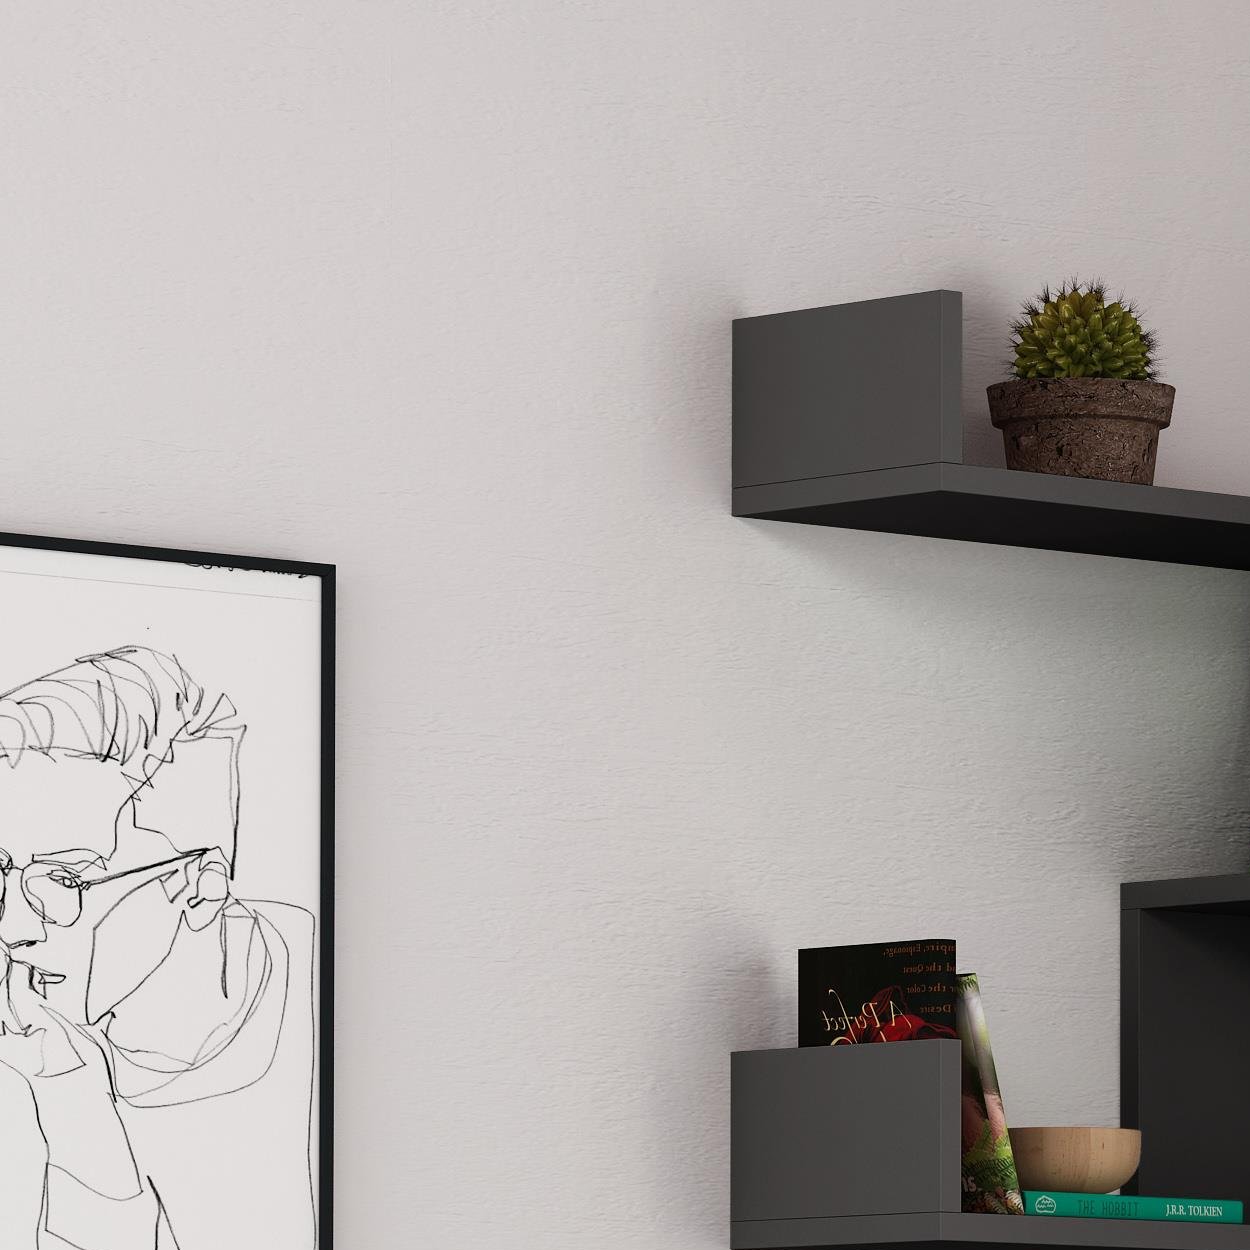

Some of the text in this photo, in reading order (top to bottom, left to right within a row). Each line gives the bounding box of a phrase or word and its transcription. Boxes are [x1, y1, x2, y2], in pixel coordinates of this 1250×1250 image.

[1078, 1199, 1140, 1217] THE HOBBIT
[1166, 1204, 1223, 1217] J.R.R. TOLKIEN
